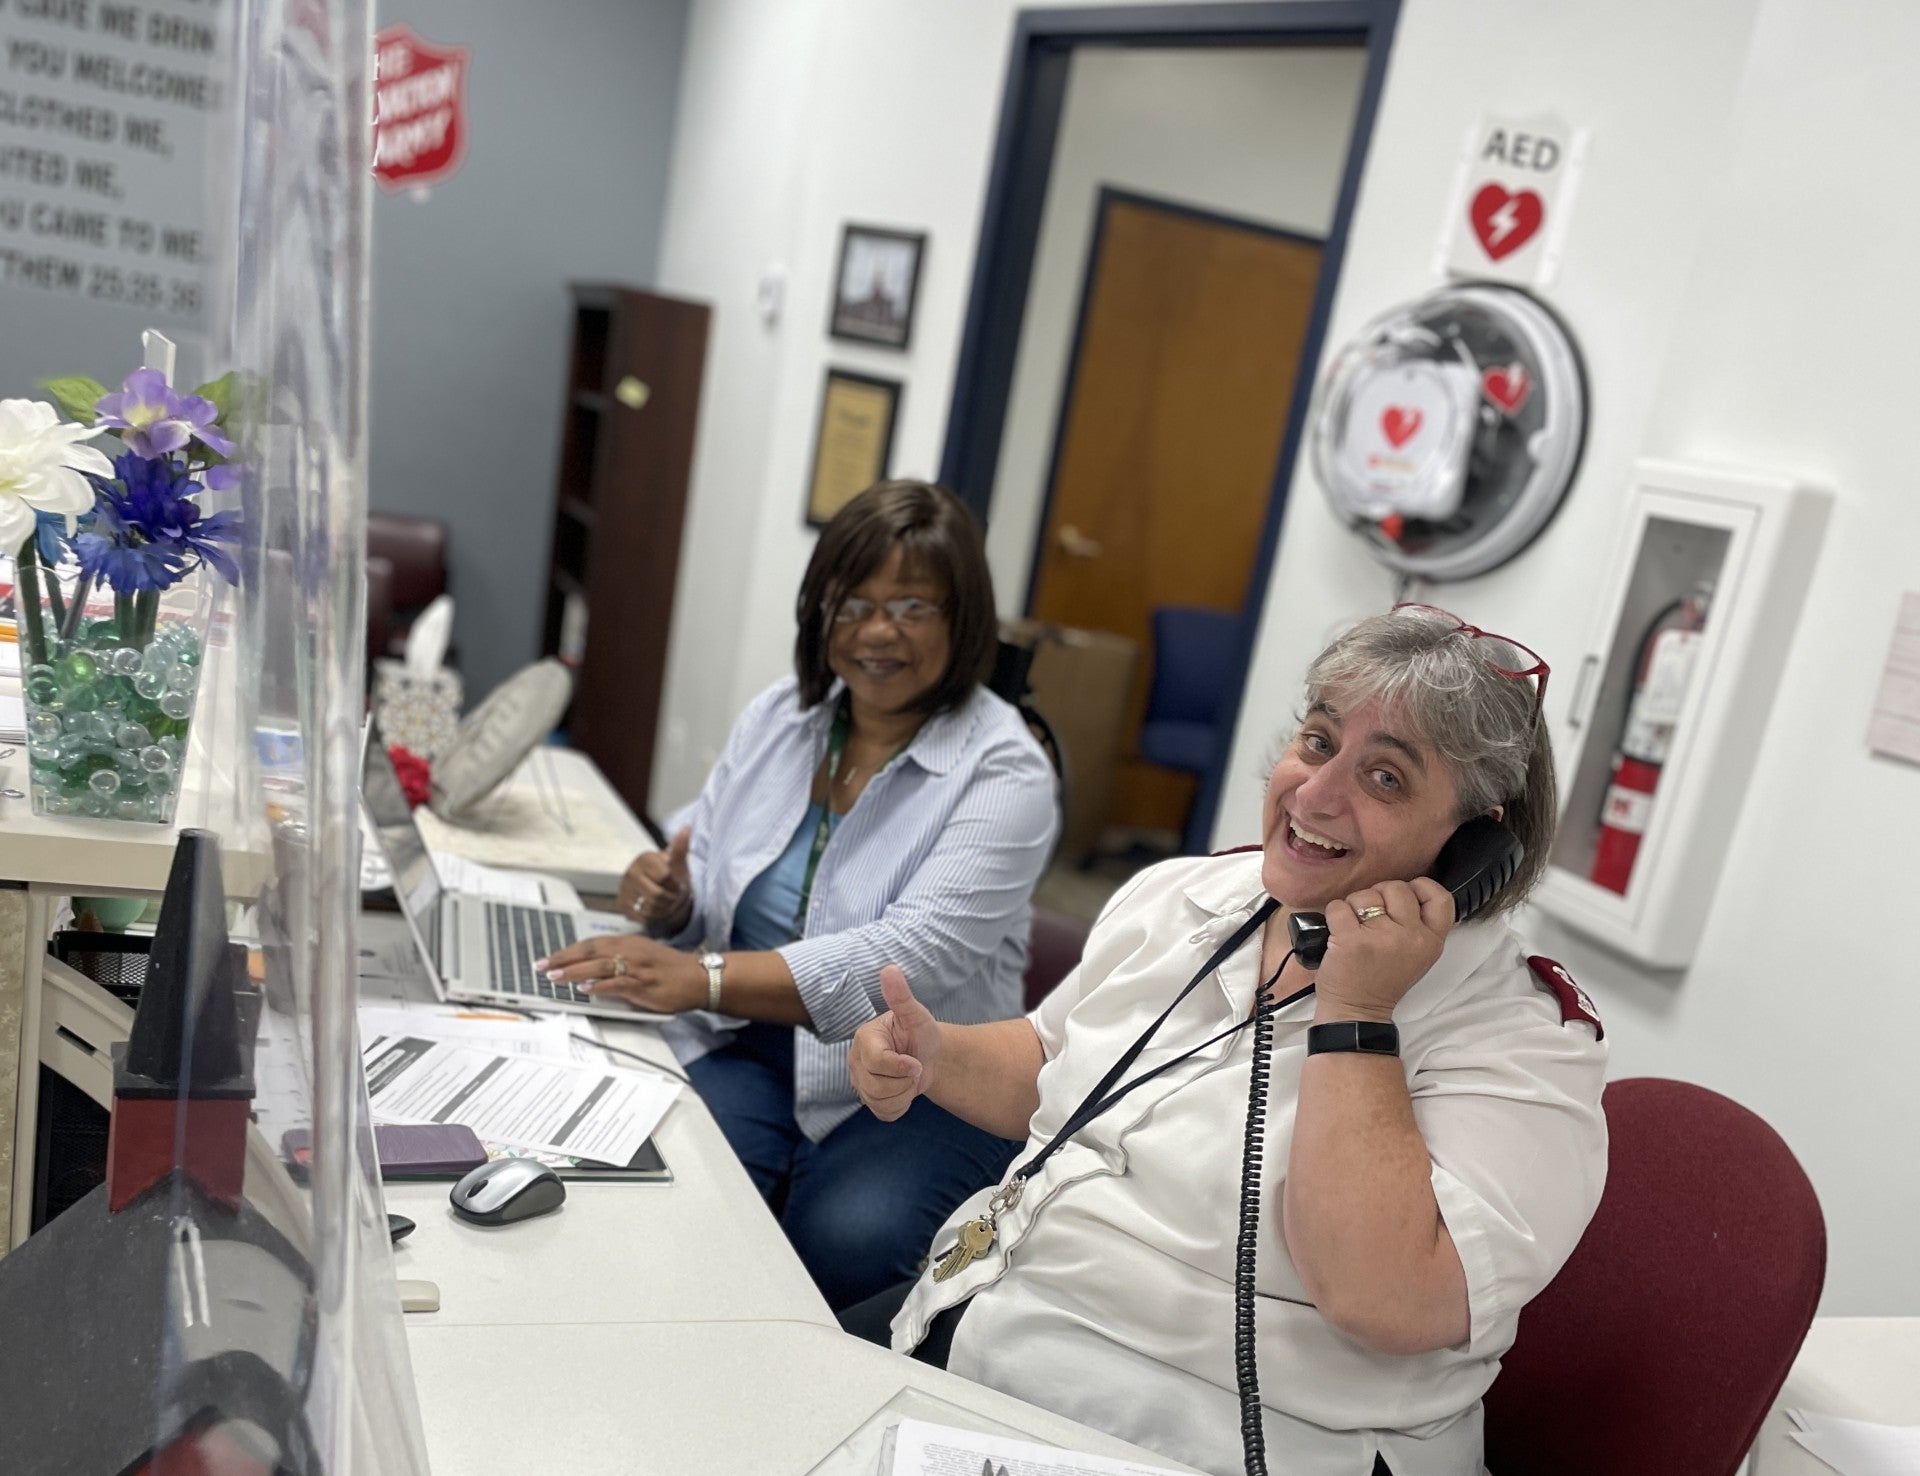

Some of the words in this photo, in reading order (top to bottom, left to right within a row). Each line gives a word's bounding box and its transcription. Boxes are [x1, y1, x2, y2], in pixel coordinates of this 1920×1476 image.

[147, 12, 215, 51] DRIN
[8, 38, 67, 78] YOU
[1481, 127, 1562, 174] AED
[30, 202, 107, 247] CAME
[119, 216, 155, 254] TO
